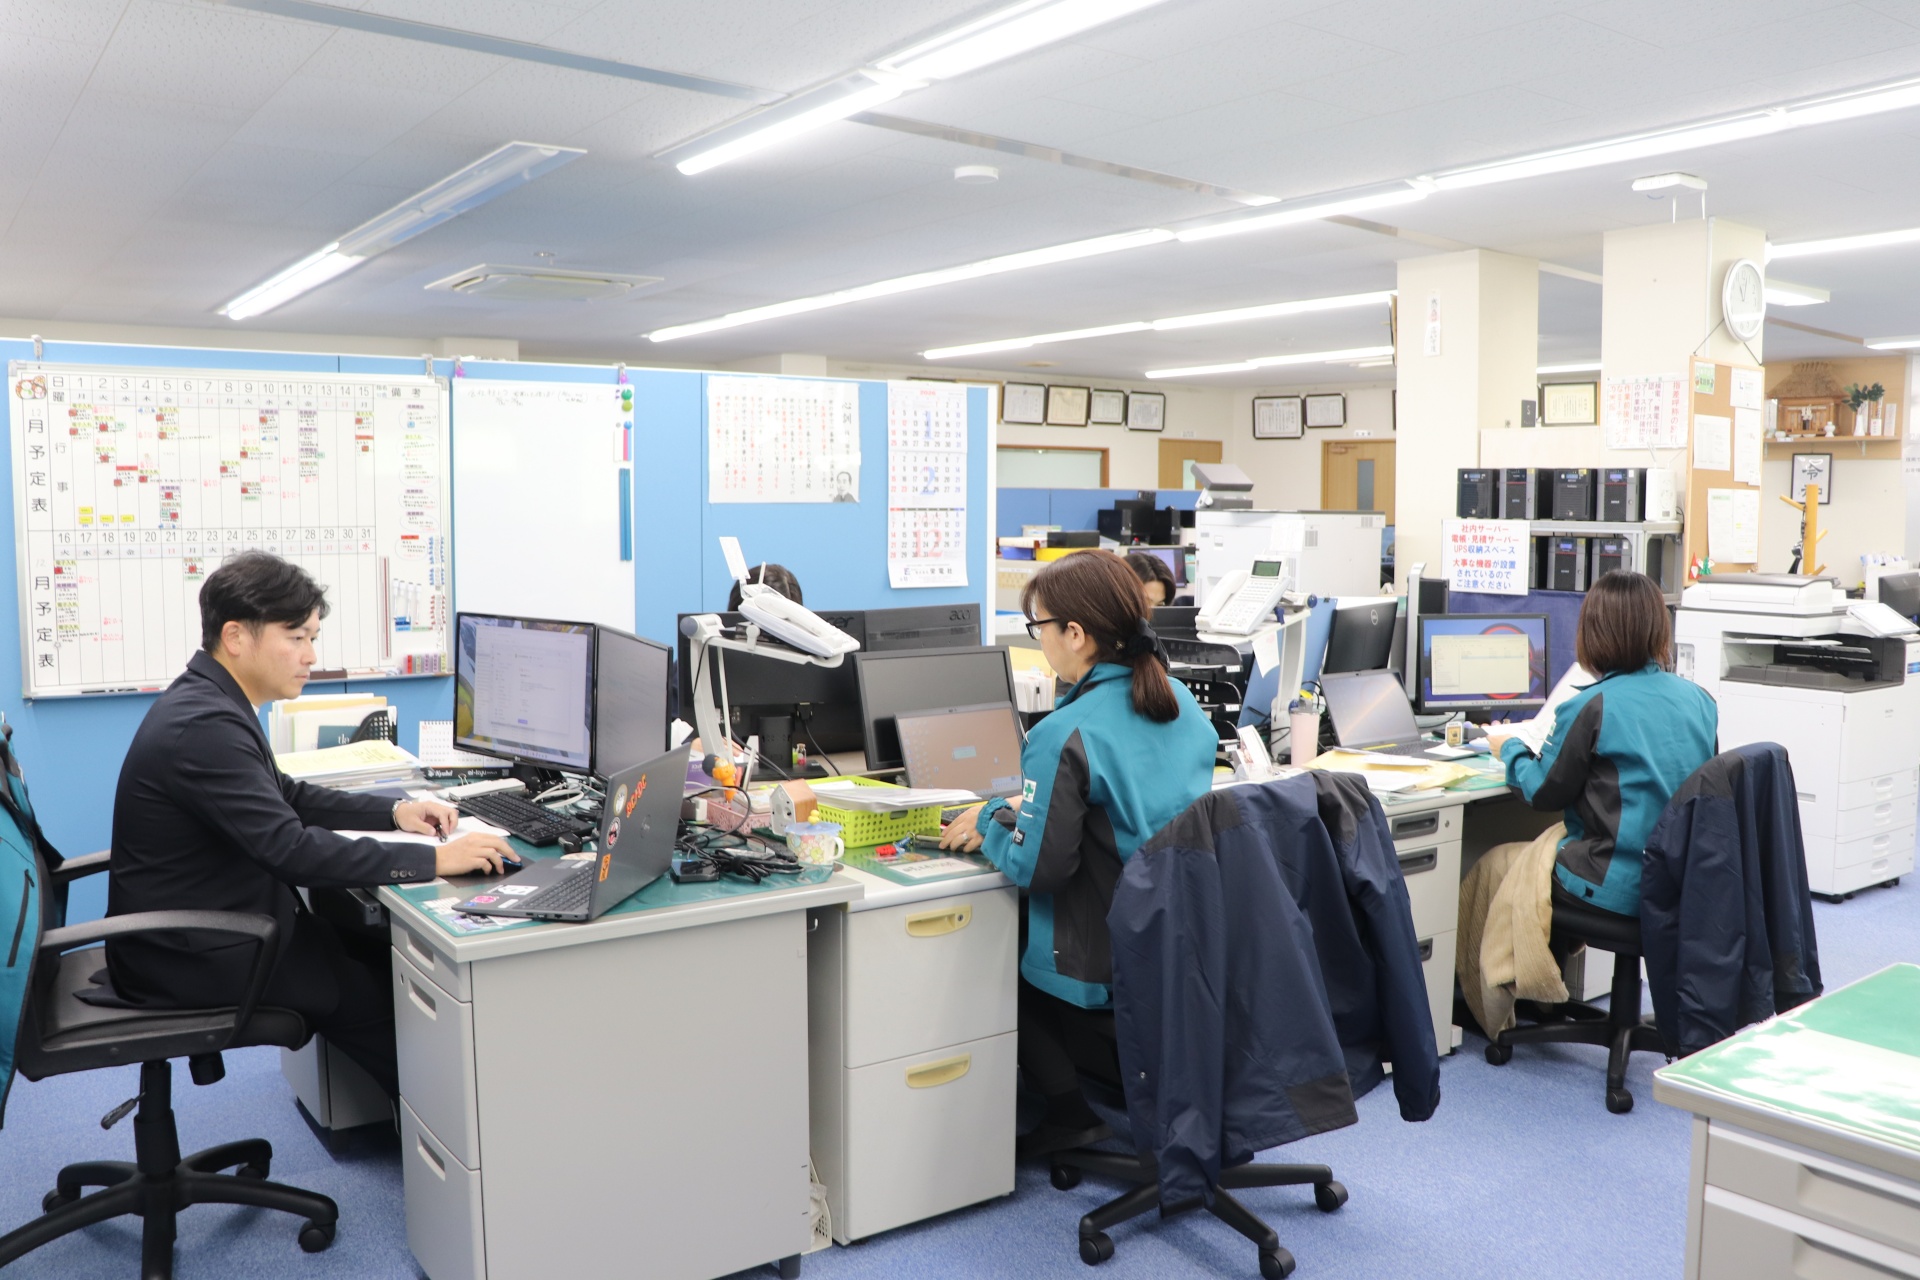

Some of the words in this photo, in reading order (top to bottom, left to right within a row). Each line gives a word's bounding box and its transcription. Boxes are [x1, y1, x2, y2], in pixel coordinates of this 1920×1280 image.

[53, 377, 63, 387] 日
[78, 378, 83, 387] 1
[99, 378, 107, 389] 2
[121, 379, 129, 389] 3
[142, 379, 150, 390] 4
[164, 380, 171, 390] 5
[184, 381, 192, 391] 6
[205, 382, 212, 392] 7
[225, 382, 232, 392] 8
[245, 383, 253, 393] 9
[264, 384, 274, 393] 10
[283, 384, 293, 394] 11
[303, 385, 312, 394] 12
[322, 385, 331, 395] 13
[340, 386, 351, 395] 14
[360, 387, 369, 396] 15
[1461, 525, 1509, 533] 社内サーバー
[58, 533, 70, 543] 16
[80, 533, 92, 543] 17
[102, 532, 114, 542] 18
[124, 532, 135, 542] 19
[145, 532, 156, 542] 20
[166, 532, 176, 541] 21
[187, 531, 198, 541] 22
[207, 531, 218, 541] 23
[227, 531, 237, 541] 24
[247, 530, 258, 540] 25
[266, 530, 277, 540] 26
[286, 529, 296, 540] 27
[305, 529, 316, 540] 28
[324, 529, 335, 539] 29
[343, 529, 353, 539] 30
[362, 529, 371, 538] 31
[1454, 545, 1515, 554] UPS収納スペース
[1453, 558, 1516, 569] 大事な機器が設置
[1457, 569, 1511, 579] されているので
[1457, 579, 1511, 589] ご注意ください
[824, 616, 854, 628] cer
